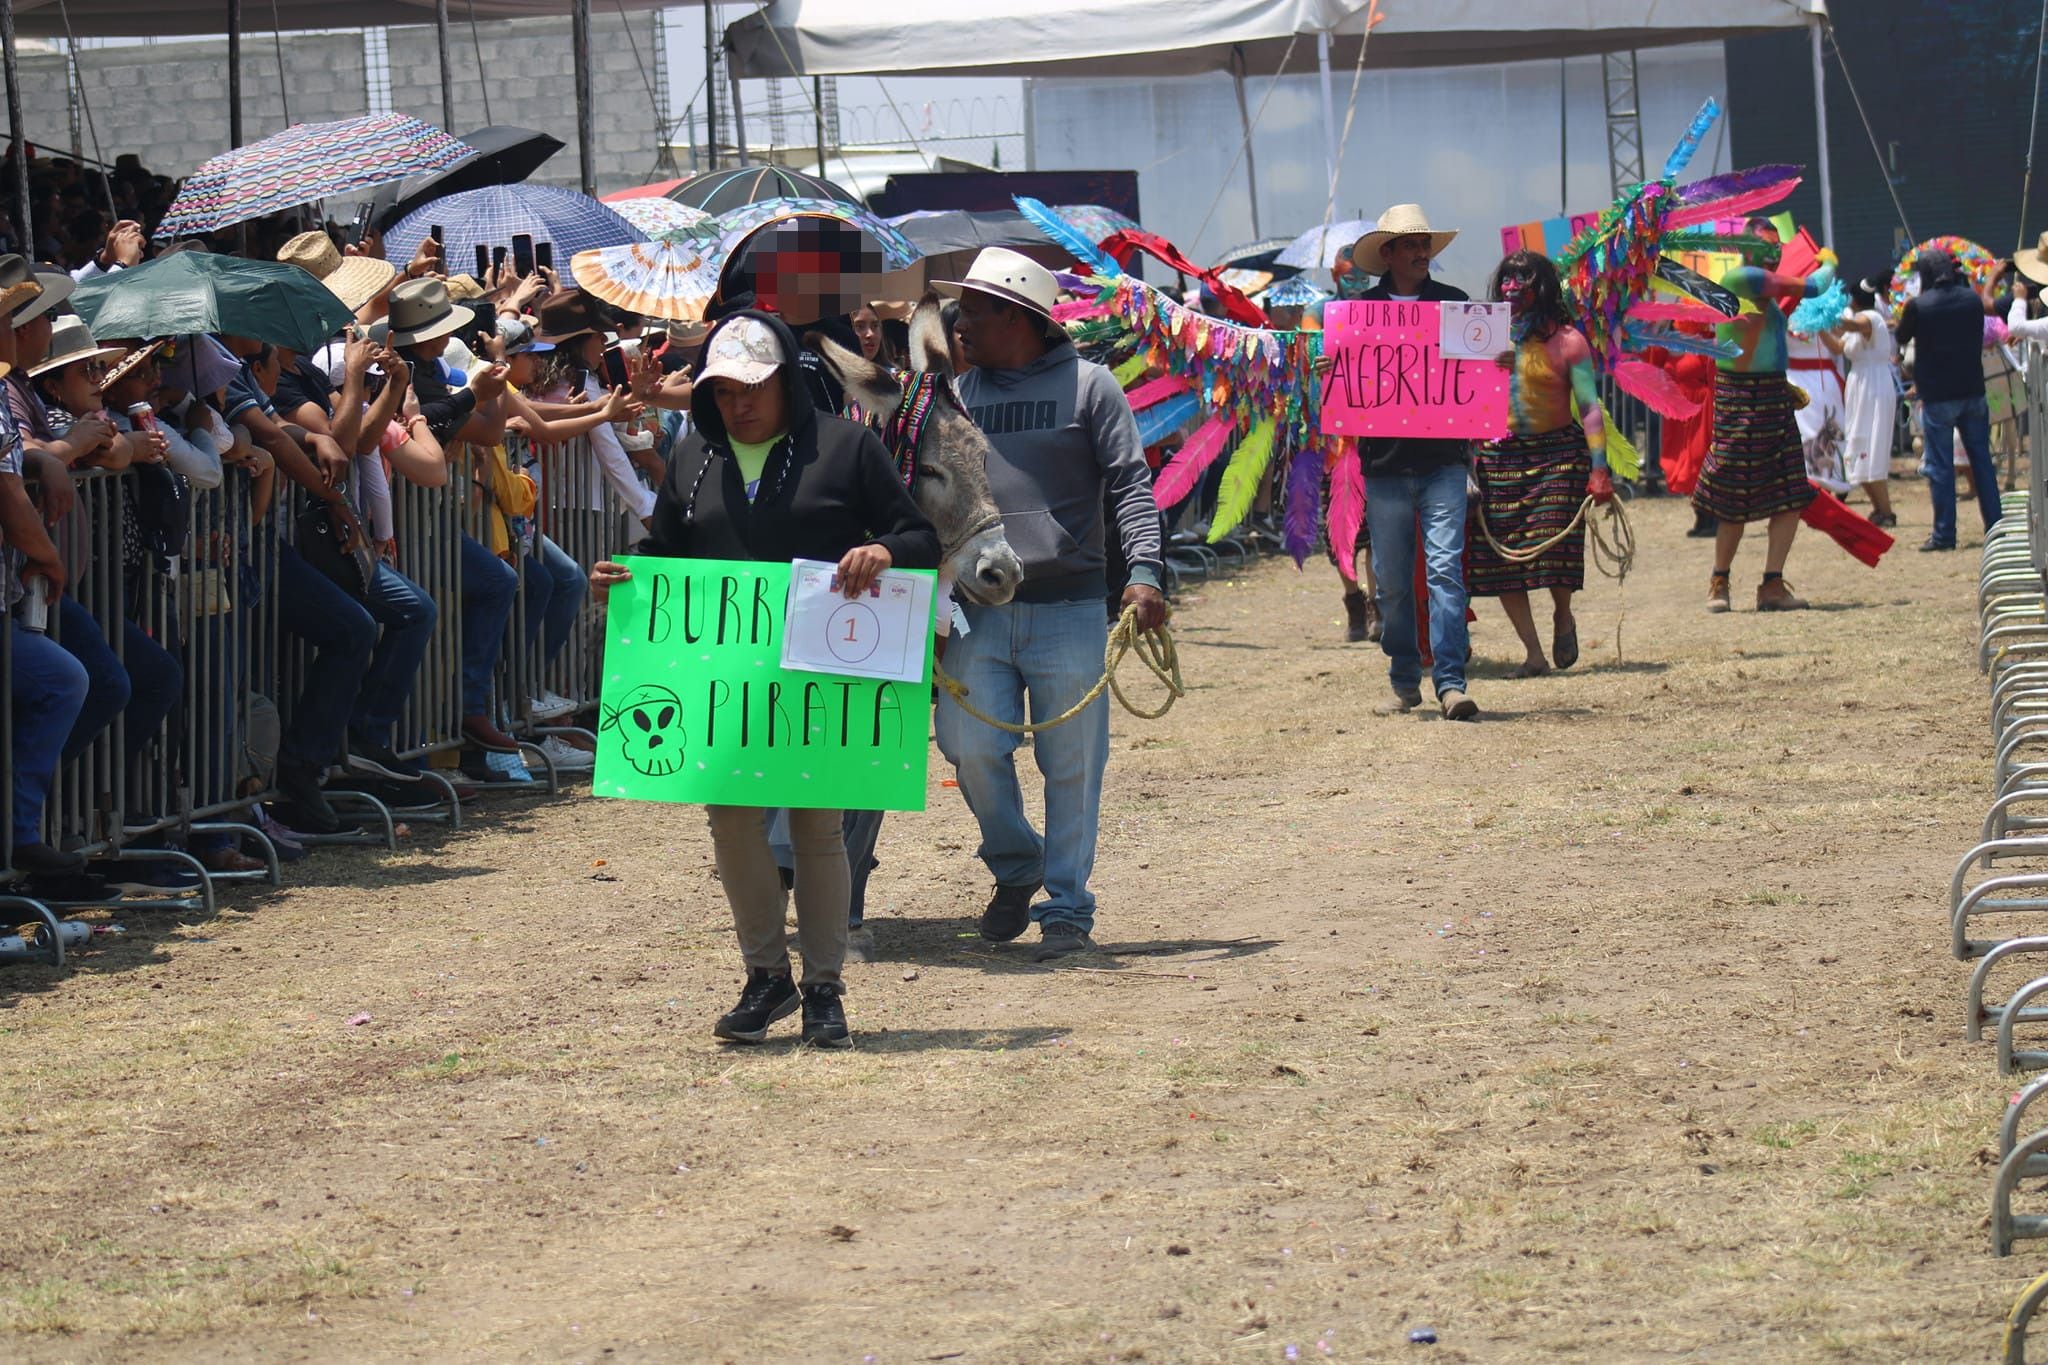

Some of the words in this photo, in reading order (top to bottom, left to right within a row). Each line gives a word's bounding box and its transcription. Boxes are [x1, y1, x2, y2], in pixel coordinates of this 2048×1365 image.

[1349, 302, 1420, 327] BURRO
[1472, 327, 1482, 342] 2
[1322, 343, 1475, 410] ALEBRIJE
[648, 573, 789, 647] BURR
[842, 617, 859, 642] 1
[707, 679, 904, 749] PIRATA
